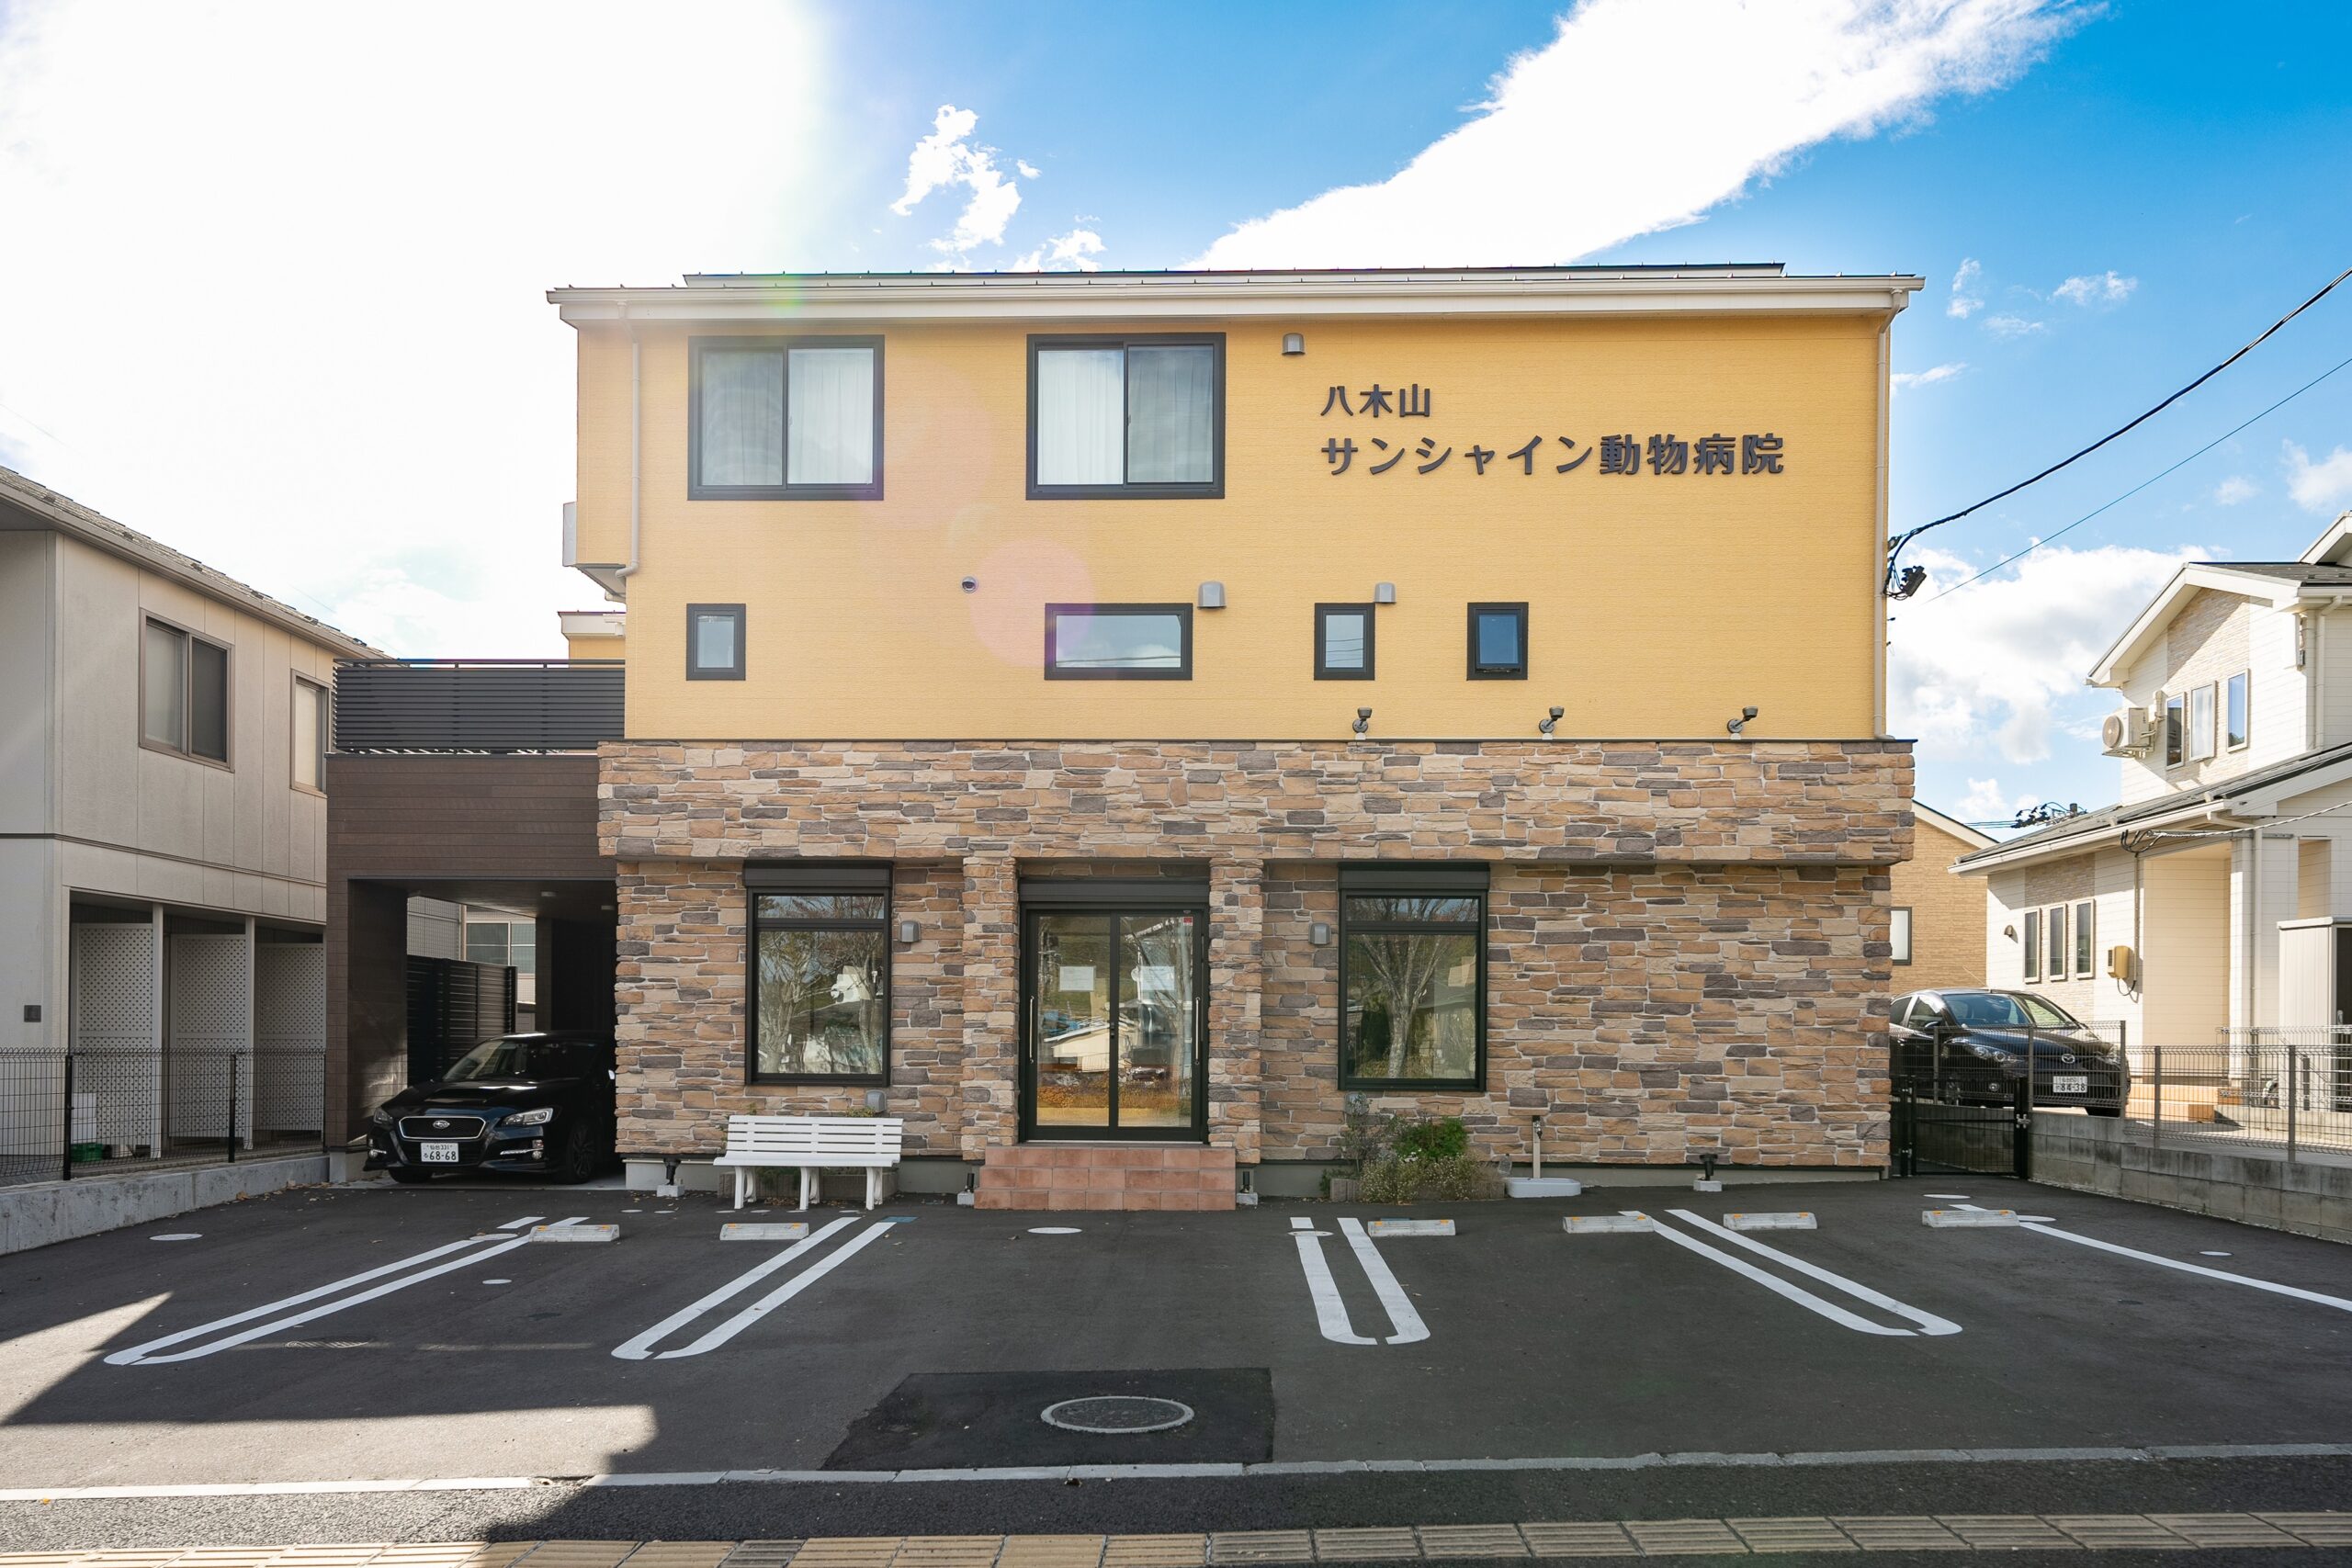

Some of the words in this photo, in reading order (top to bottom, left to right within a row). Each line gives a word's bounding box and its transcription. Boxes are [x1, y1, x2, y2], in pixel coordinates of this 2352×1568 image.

[1320, 383, 1430, 419] 八木山
[1321, 432, 1784, 476] サンシャイン動物病院
[429, 1151, 457, 1160] 68-68
